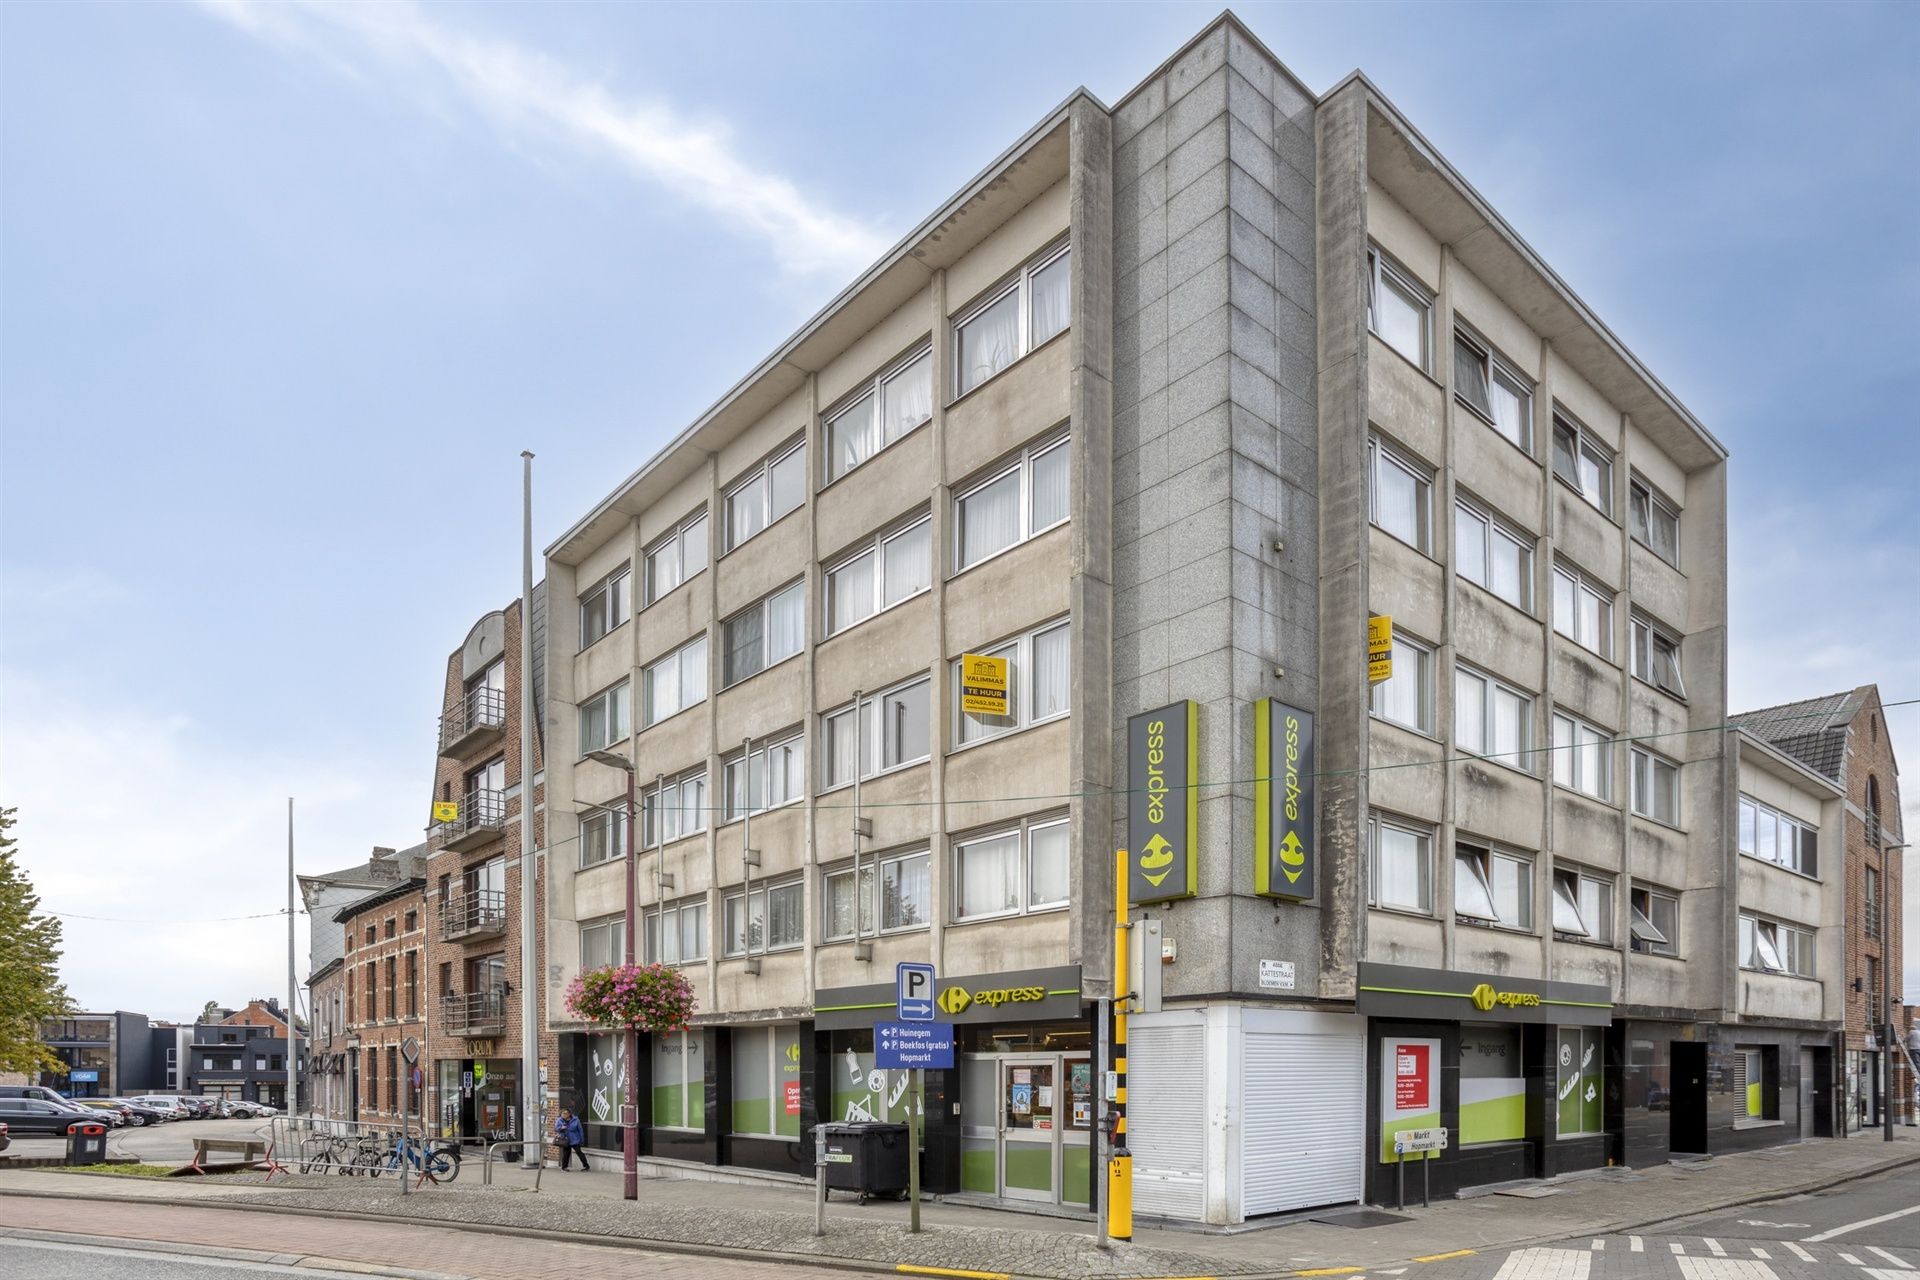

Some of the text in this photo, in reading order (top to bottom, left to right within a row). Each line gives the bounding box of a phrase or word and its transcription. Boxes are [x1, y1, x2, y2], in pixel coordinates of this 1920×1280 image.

[966, 675, 1004, 685] VALIMMAS
[980, 689, 1003, 698] HUUR
[965, 698, 1004, 708] 02/452.59.25
[1147, 720, 1169, 824] express
[1285, 715, 1302, 821] express
[1261, 970, 1294, 979] KATTESTRAAT
[908, 971, 926, 998] P
[974, 986, 1046, 1008] express
[1497, 991, 1541, 1009] express
[899, 1029, 931, 1039] Huinegem
[926, 1041, 950, 1051] (gratis)
[1478, 1042, 1506, 1057] Ingang
[900, 1053, 932, 1063] Hopmarkt
[1413, 1130, 1431, 1140] Markt
[1411, 1141, 1436, 1150] Hopmarkt
